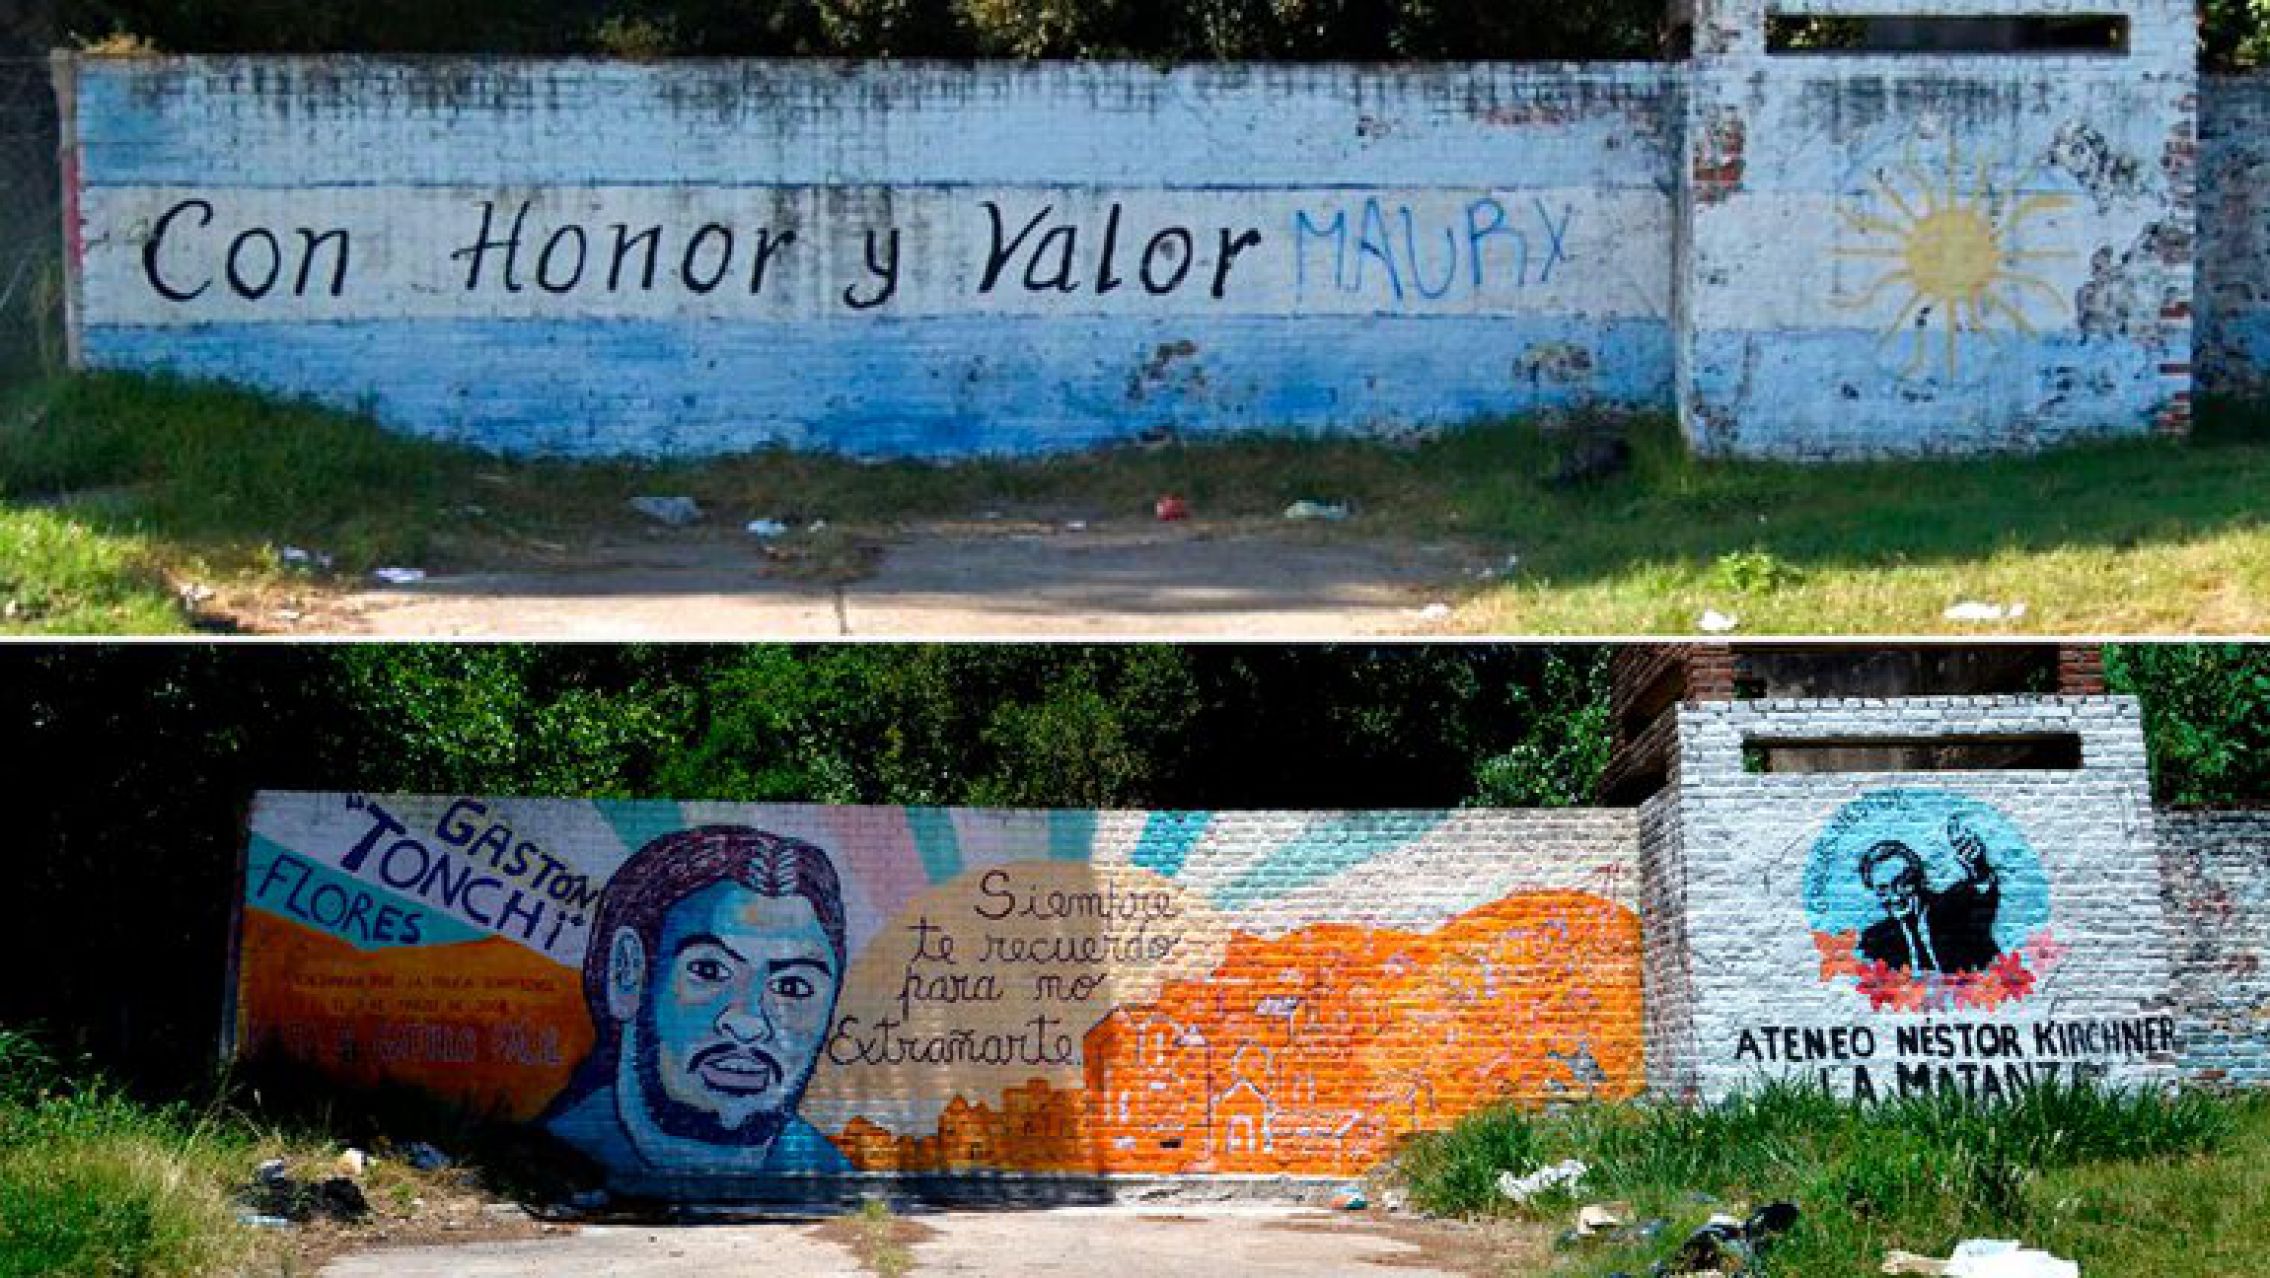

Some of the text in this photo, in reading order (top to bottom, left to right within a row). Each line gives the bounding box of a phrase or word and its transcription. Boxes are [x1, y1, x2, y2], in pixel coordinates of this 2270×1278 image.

[142, 199, 351, 301] Con
[451, 199, 798, 295] Honor
[842, 225, 900, 308] y
[977, 201, 1262, 298] Valor
[435, 798, 603, 911] GASTON
[257, 853, 423, 944] FLORES
[973, 869, 1182, 932] Siempre
[906, 917, 1182, 965] te recuerdo
[898, 966, 1004, 1020] para
[1735, 1026, 1874, 1060] ATENEO
[2033, 1015, 2174, 1055] KIRCHNER
